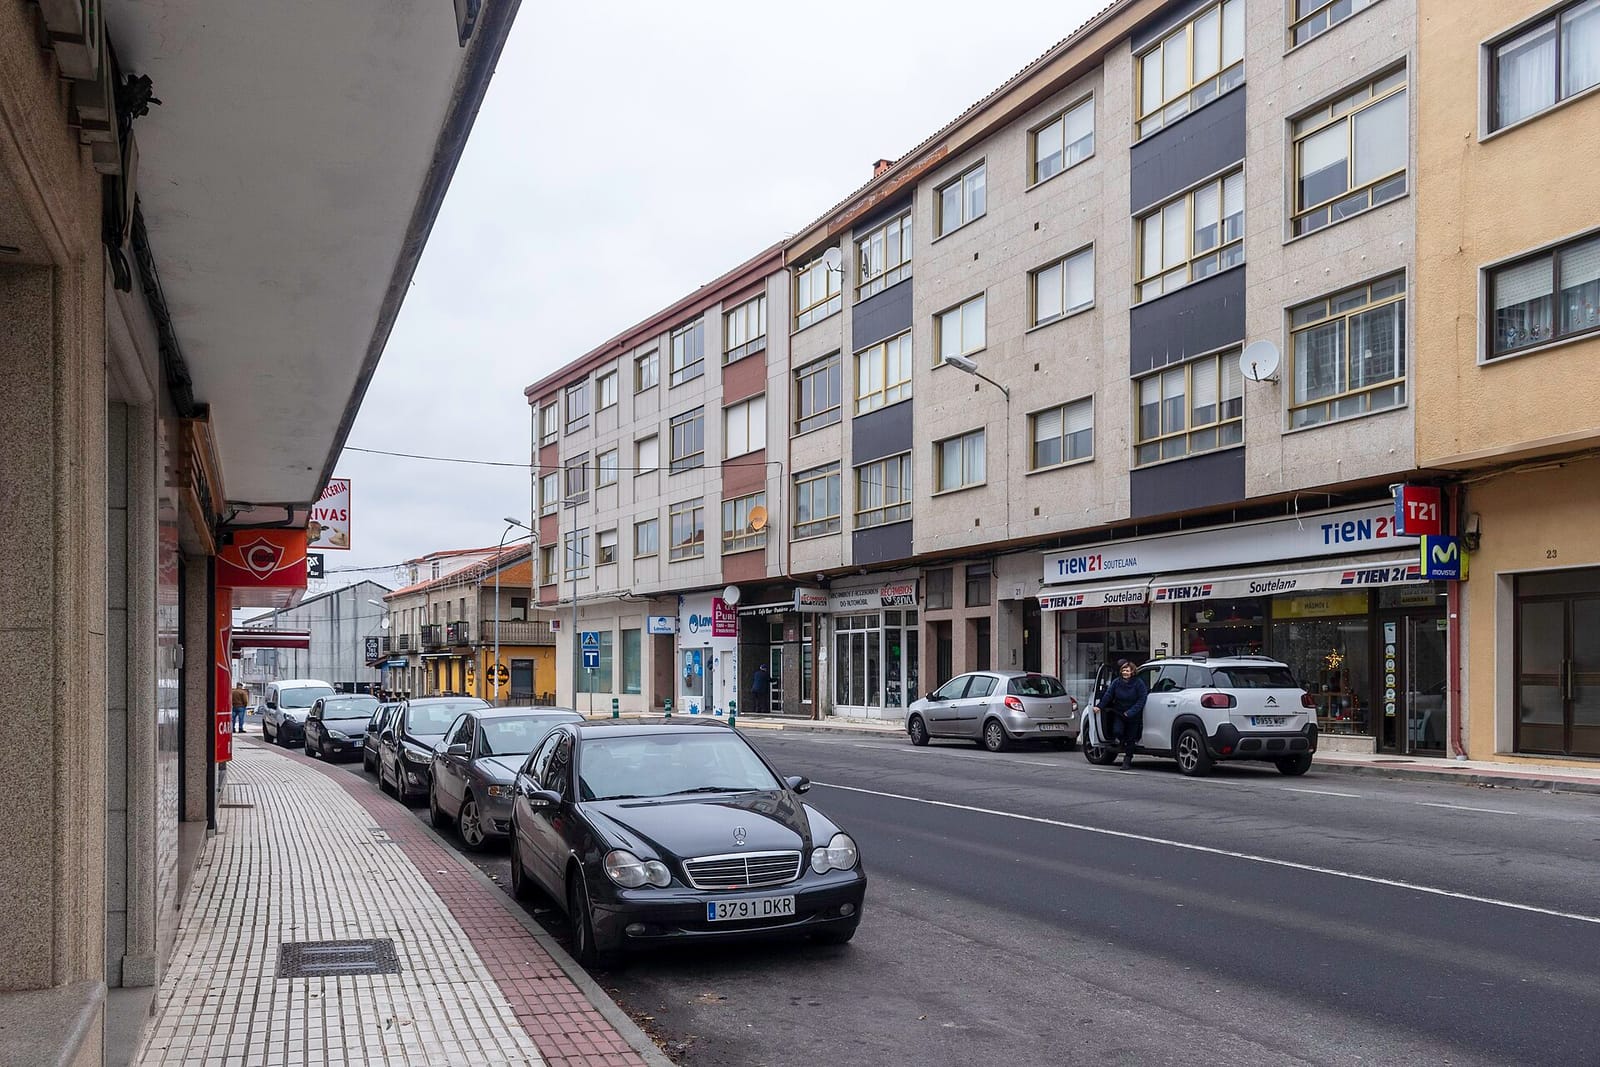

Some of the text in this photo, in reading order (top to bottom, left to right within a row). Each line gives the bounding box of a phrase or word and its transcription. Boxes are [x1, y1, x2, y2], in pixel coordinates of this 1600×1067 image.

[1407, 501, 1436, 521] T21
[1546, 549, 1558, 559] 23
[1088, 554, 1102, 572] 21
[1103, 557, 1138, 570] SOUTELANA
[1356, 568, 1406, 584] TIEN 21
[1168, 586, 1202, 599] TIEN 21
[1248, 578, 1297, 594] Soutelana
[1050, 595, 1077, 609] TIEN 21
[1103, 591, 1143, 604] Soutelana
[718, 898, 793, 919] 3791 DKR
